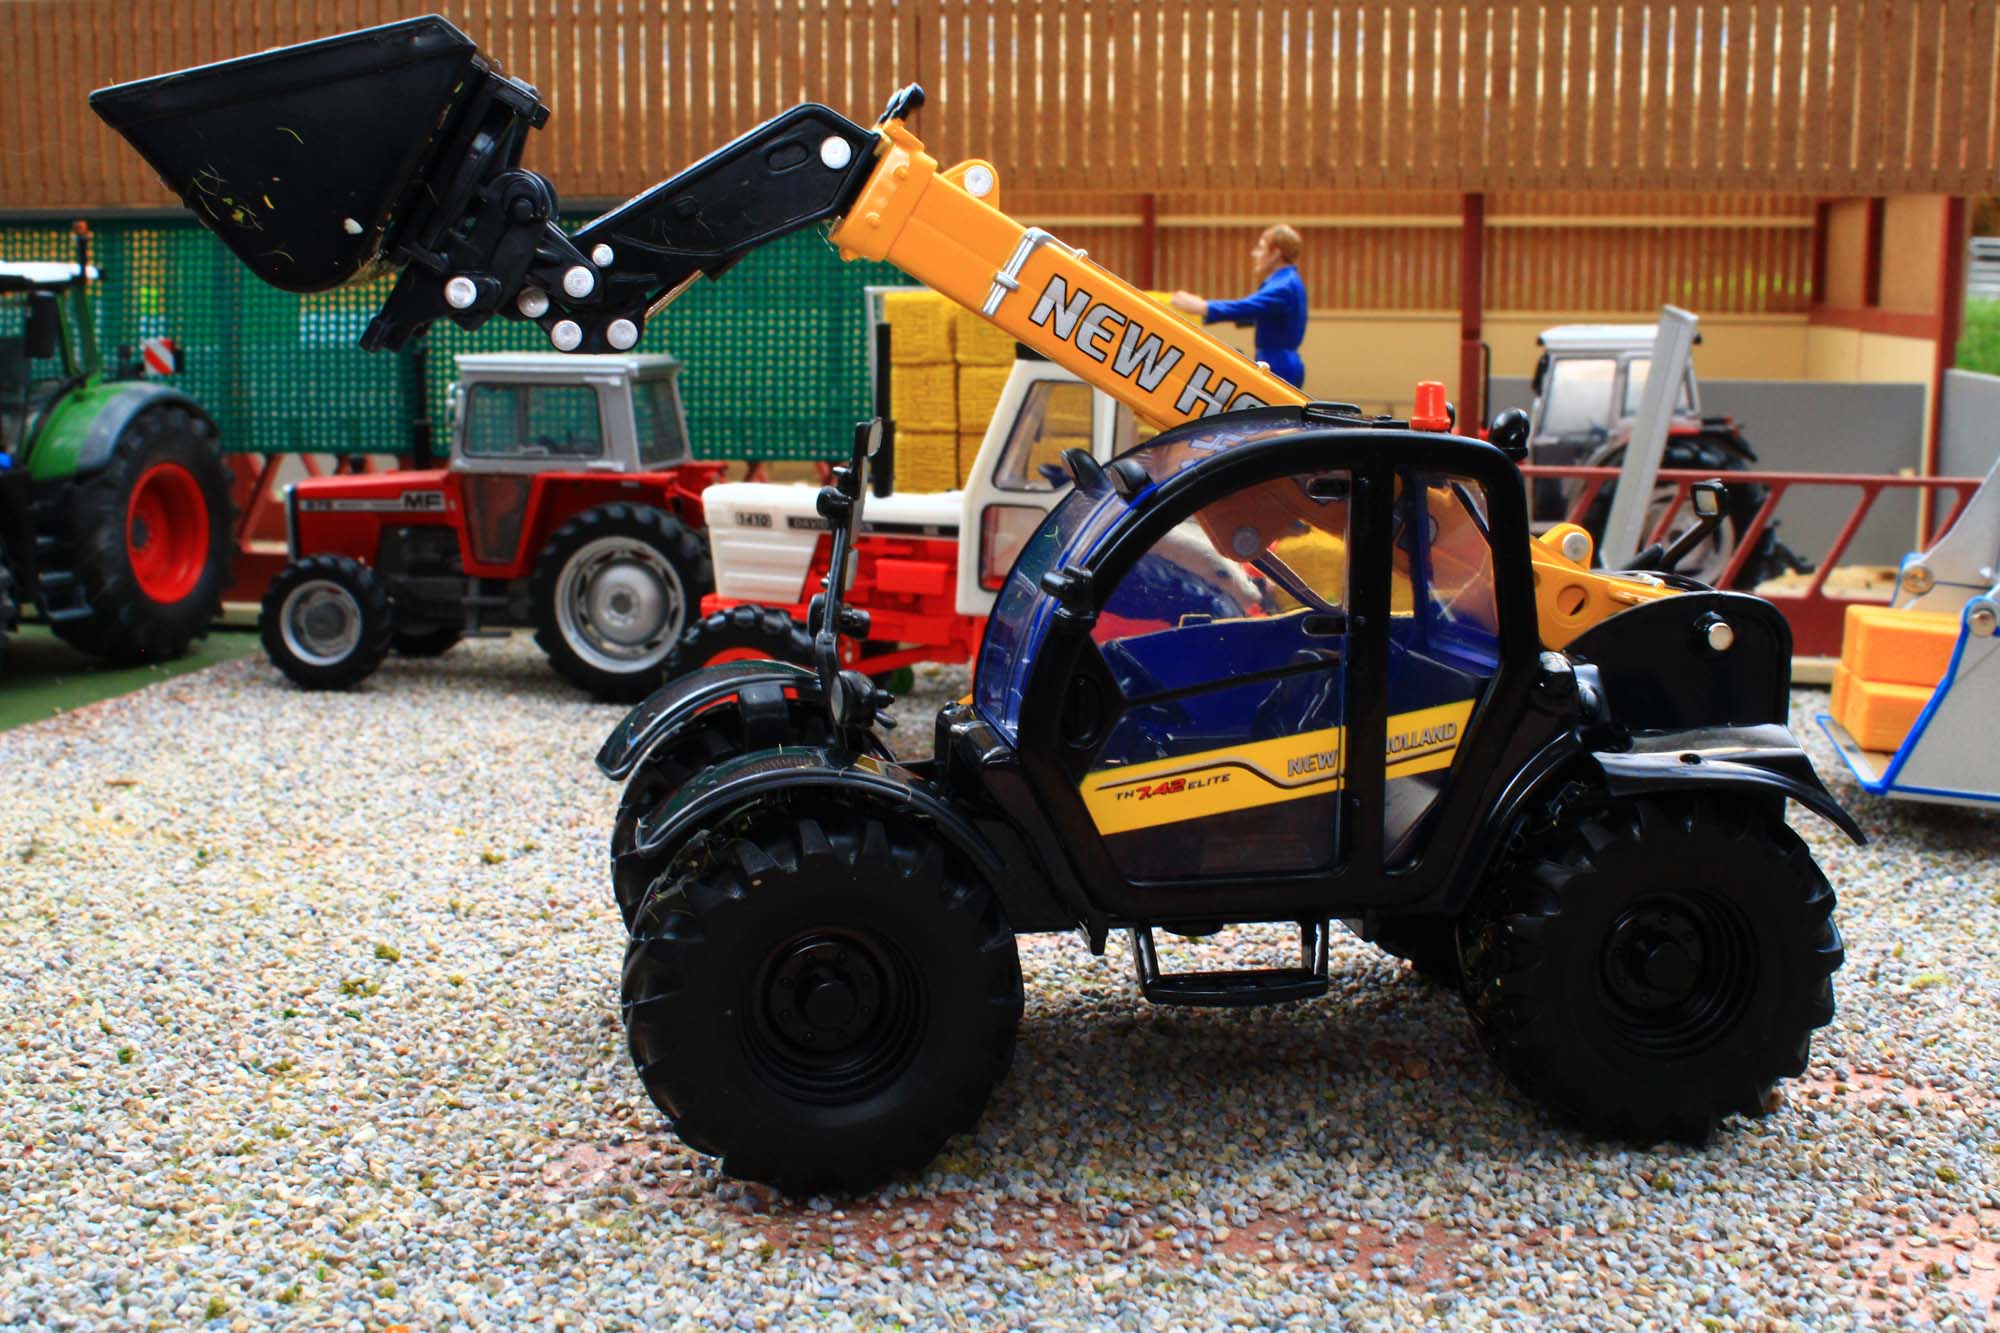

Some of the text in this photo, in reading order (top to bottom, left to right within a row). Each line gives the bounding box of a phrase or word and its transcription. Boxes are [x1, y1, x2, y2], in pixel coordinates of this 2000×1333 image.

[1028, 273, 1185, 394] NEW
[404, 493, 441, 508] MF
[1287, 750, 1338, 777] NEW
[1187, 773, 1231, 790] ELITE
